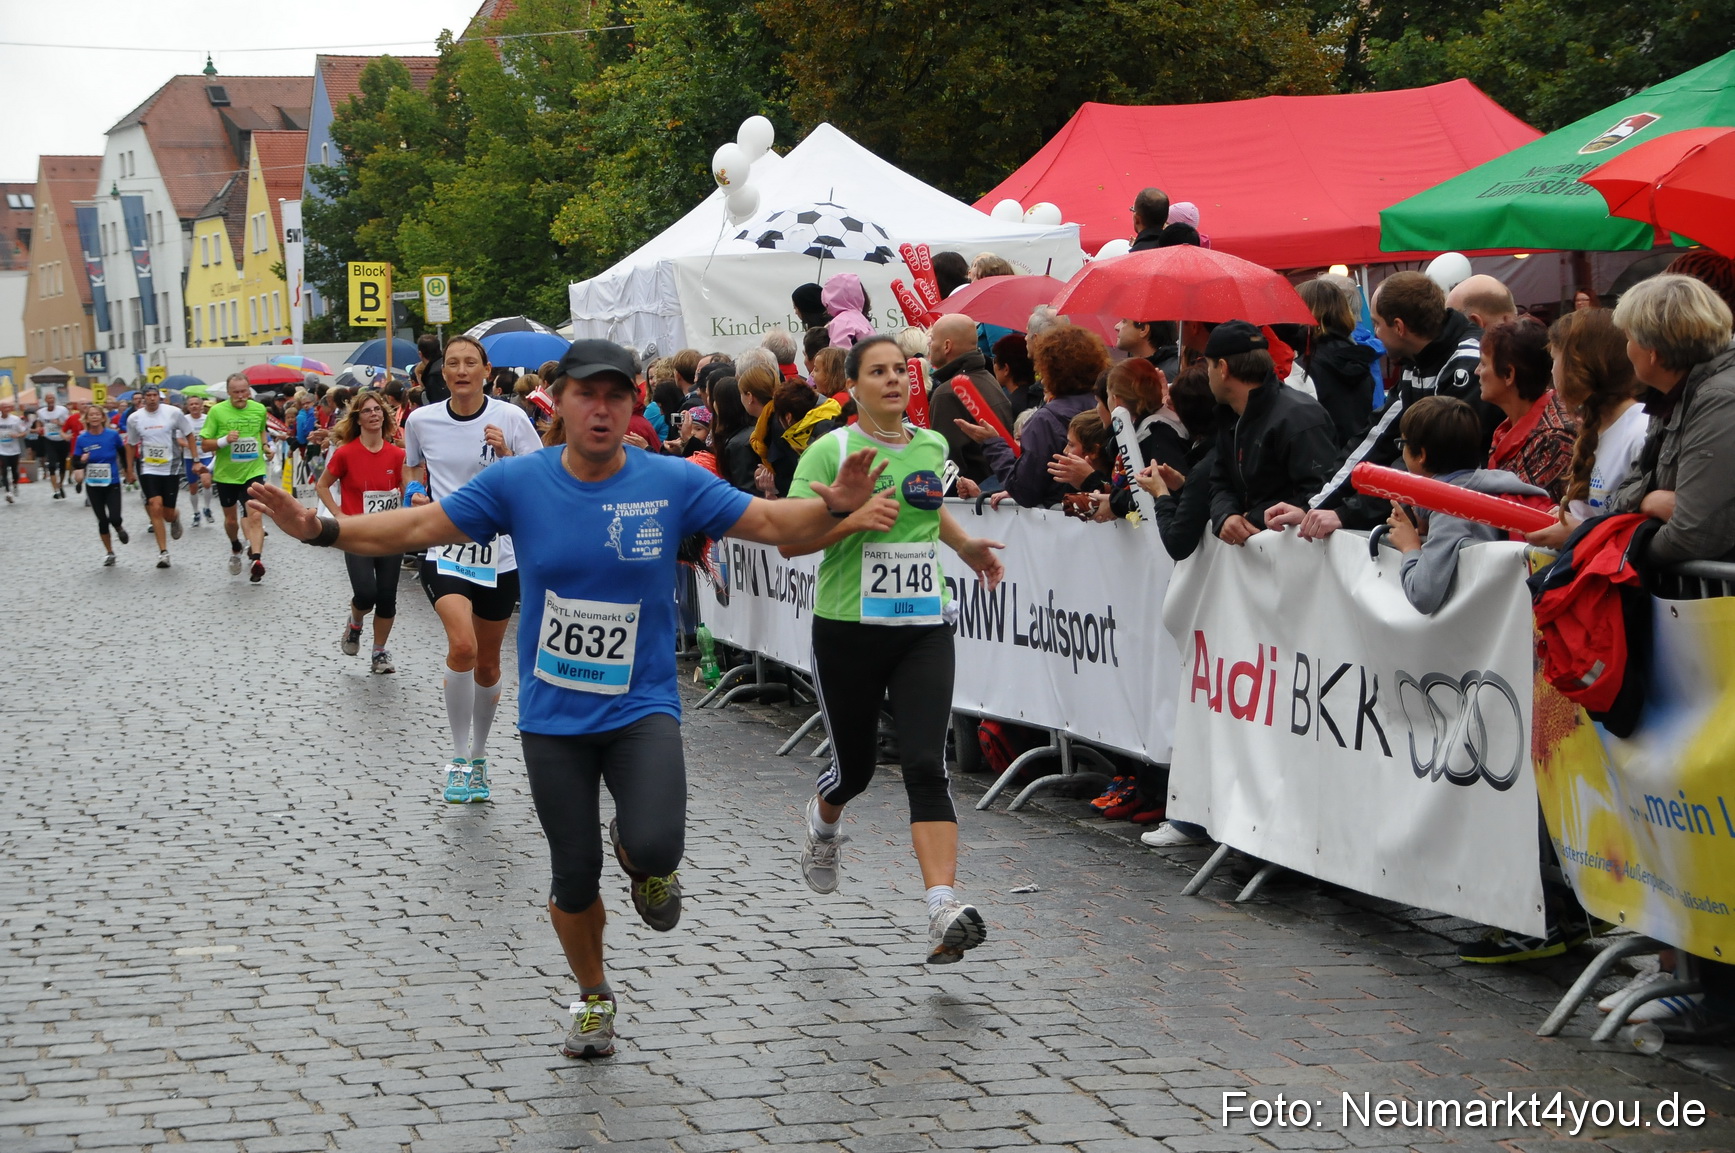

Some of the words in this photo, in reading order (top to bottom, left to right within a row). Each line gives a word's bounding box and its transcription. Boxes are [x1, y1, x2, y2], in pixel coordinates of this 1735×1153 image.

[353, 264, 387, 277] Block
[360, 282, 381, 312] B
[431, 282, 440, 293] H
[710, 315, 782, 337] Kinder
[148, 448, 165, 458] 392
[233, 442, 257, 453] 2022
[368, 497, 399, 514] 2303
[602, 503, 616, 511] 12.
[616, 499, 669, 510] NEUMARKTER
[615, 507, 659, 517] STADTLAUF
[442, 543, 493, 565] 2710
[864, 551, 893, 559] PARTL
[894, 550, 927, 559] Neumarkt
[870, 562, 933, 594] 2148
[546, 599, 571, 618] PARTL
[573, 609, 622, 622] Neumarkt
[894, 602, 914, 614] Ulla
[546, 617, 627, 659] 2632
[1012, 583, 1119, 674] Laufsport
[557, 661, 606, 681] Werner
[1190, 629, 1277, 727] Audi
[1291, 652, 1393, 757] BKK
[1717, 796, 1735, 839] L
